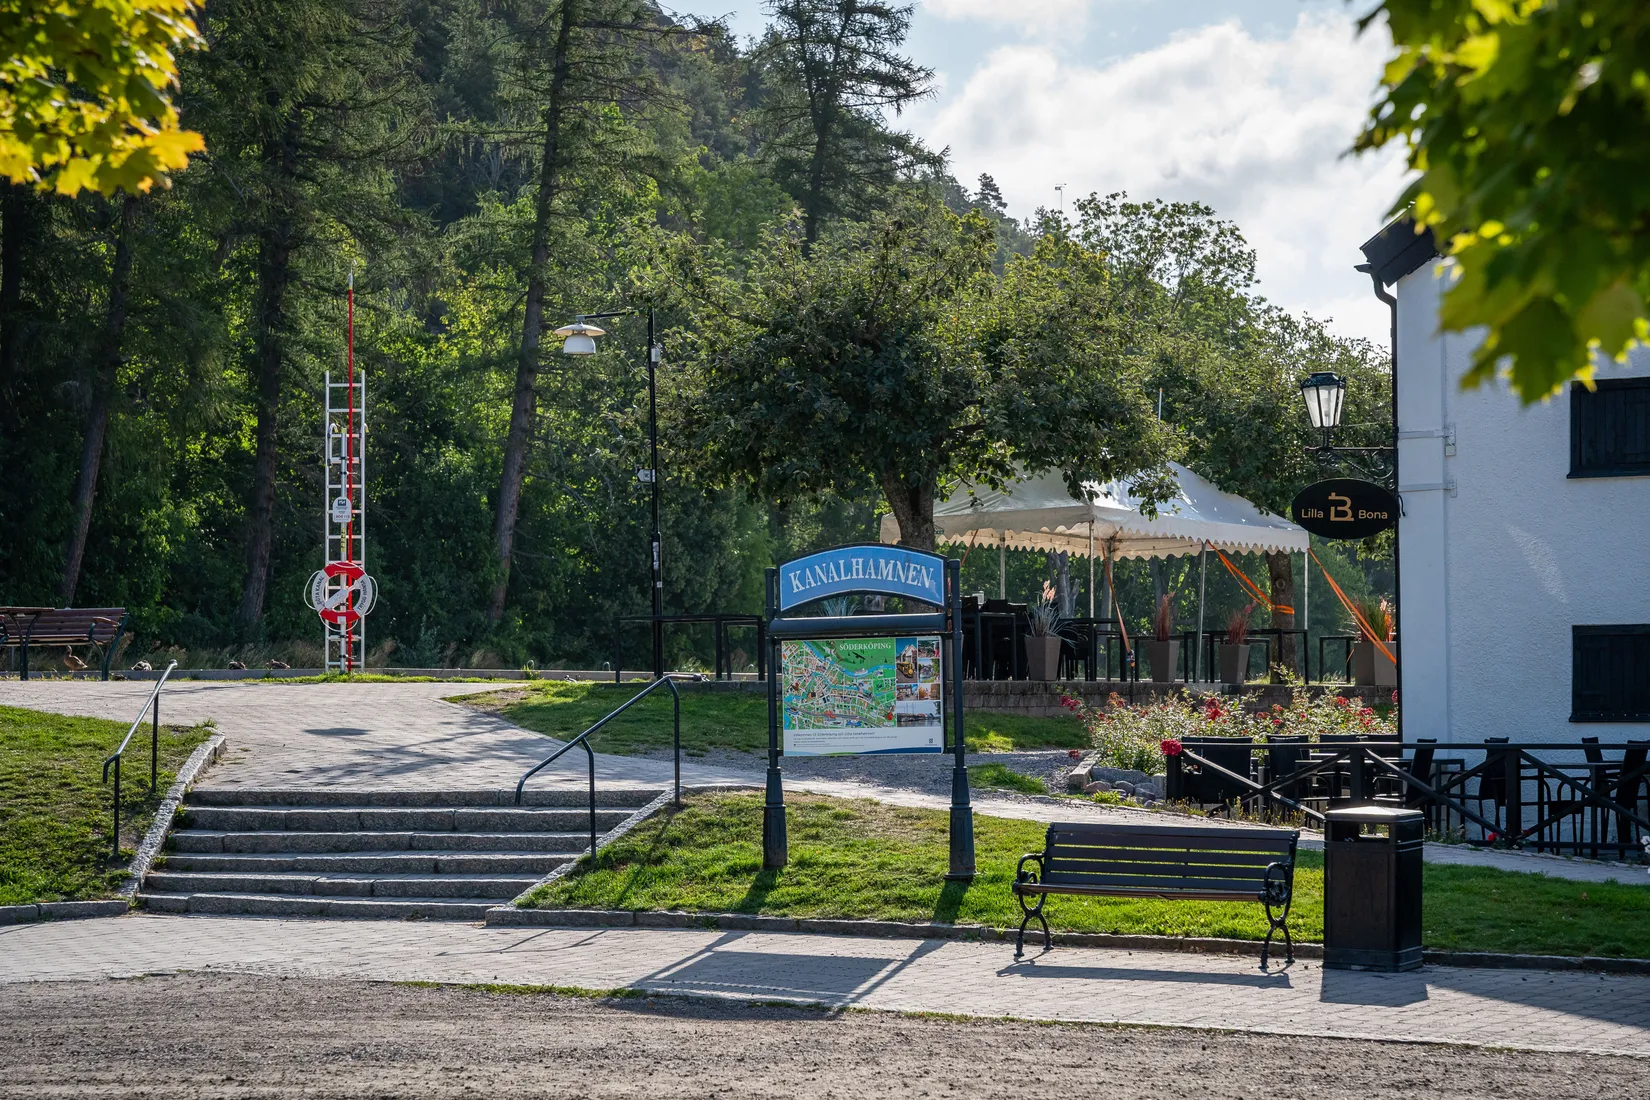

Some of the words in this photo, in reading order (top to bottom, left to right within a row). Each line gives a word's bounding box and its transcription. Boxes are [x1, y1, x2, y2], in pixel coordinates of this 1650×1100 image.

[1301, 508, 1324, 519] Lilla
[1358, 509, 1388, 520] Bona
[788, 557, 935, 594] KANALHAMNEN
[839, 641, 892, 651] SÖDERKÖPING
